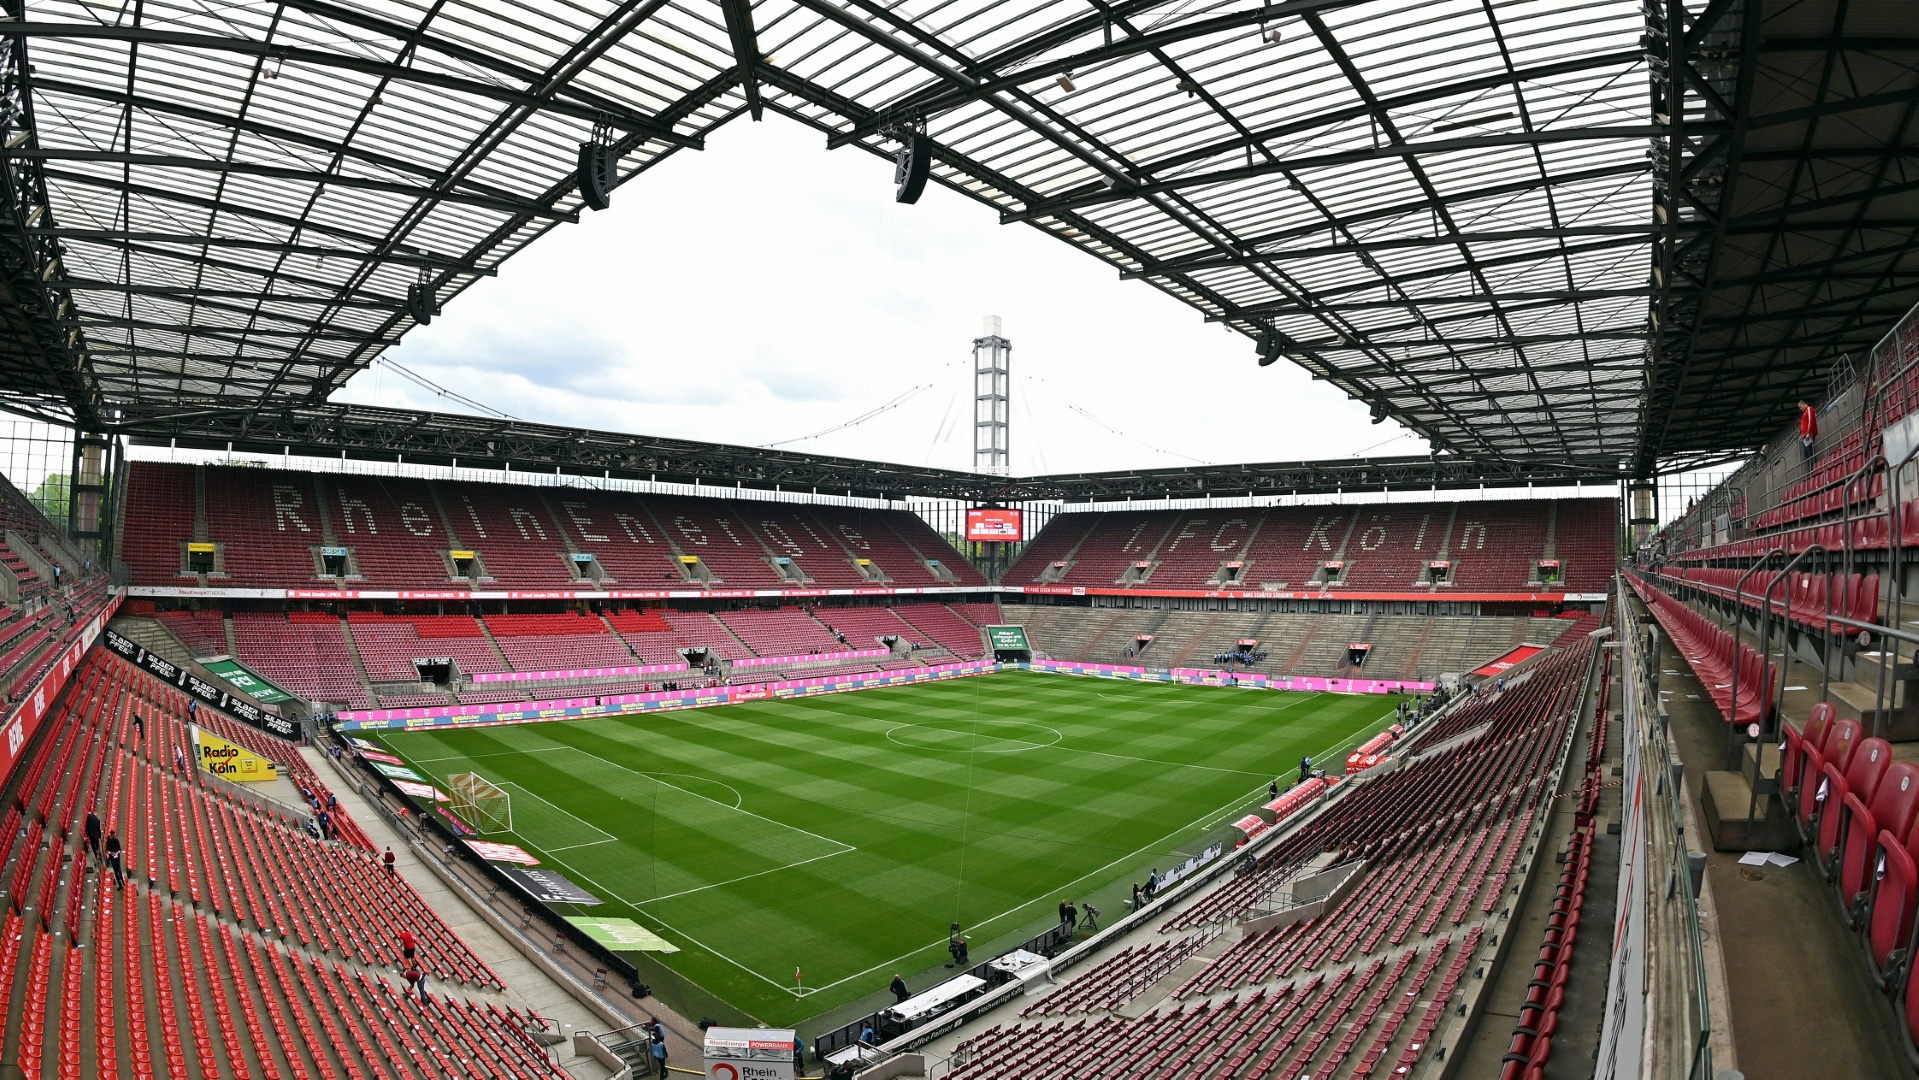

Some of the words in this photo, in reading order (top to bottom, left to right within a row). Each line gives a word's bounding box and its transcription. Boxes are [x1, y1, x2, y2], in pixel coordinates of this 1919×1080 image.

[107, 631, 133, 650] SILBER
[148, 655, 174, 673] SILBER
[190, 677, 216, 694] SILBER
[231, 698, 258, 716] SILBER
[264, 714, 292, 729] SILBER
[8, 715, 24, 758] REWE
[204, 745, 238, 758] Radio
[209, 762, 237, 774] Köln
[909, 1035, 930, 1050] Kaffee
[930, 1025, 954, 1041] Partner
[978, 993, 1011, 1014] Hochwertige
[751, 1041, 789, 1049] POWERBANK
[742, 1066, 777, 1077] Rhein
